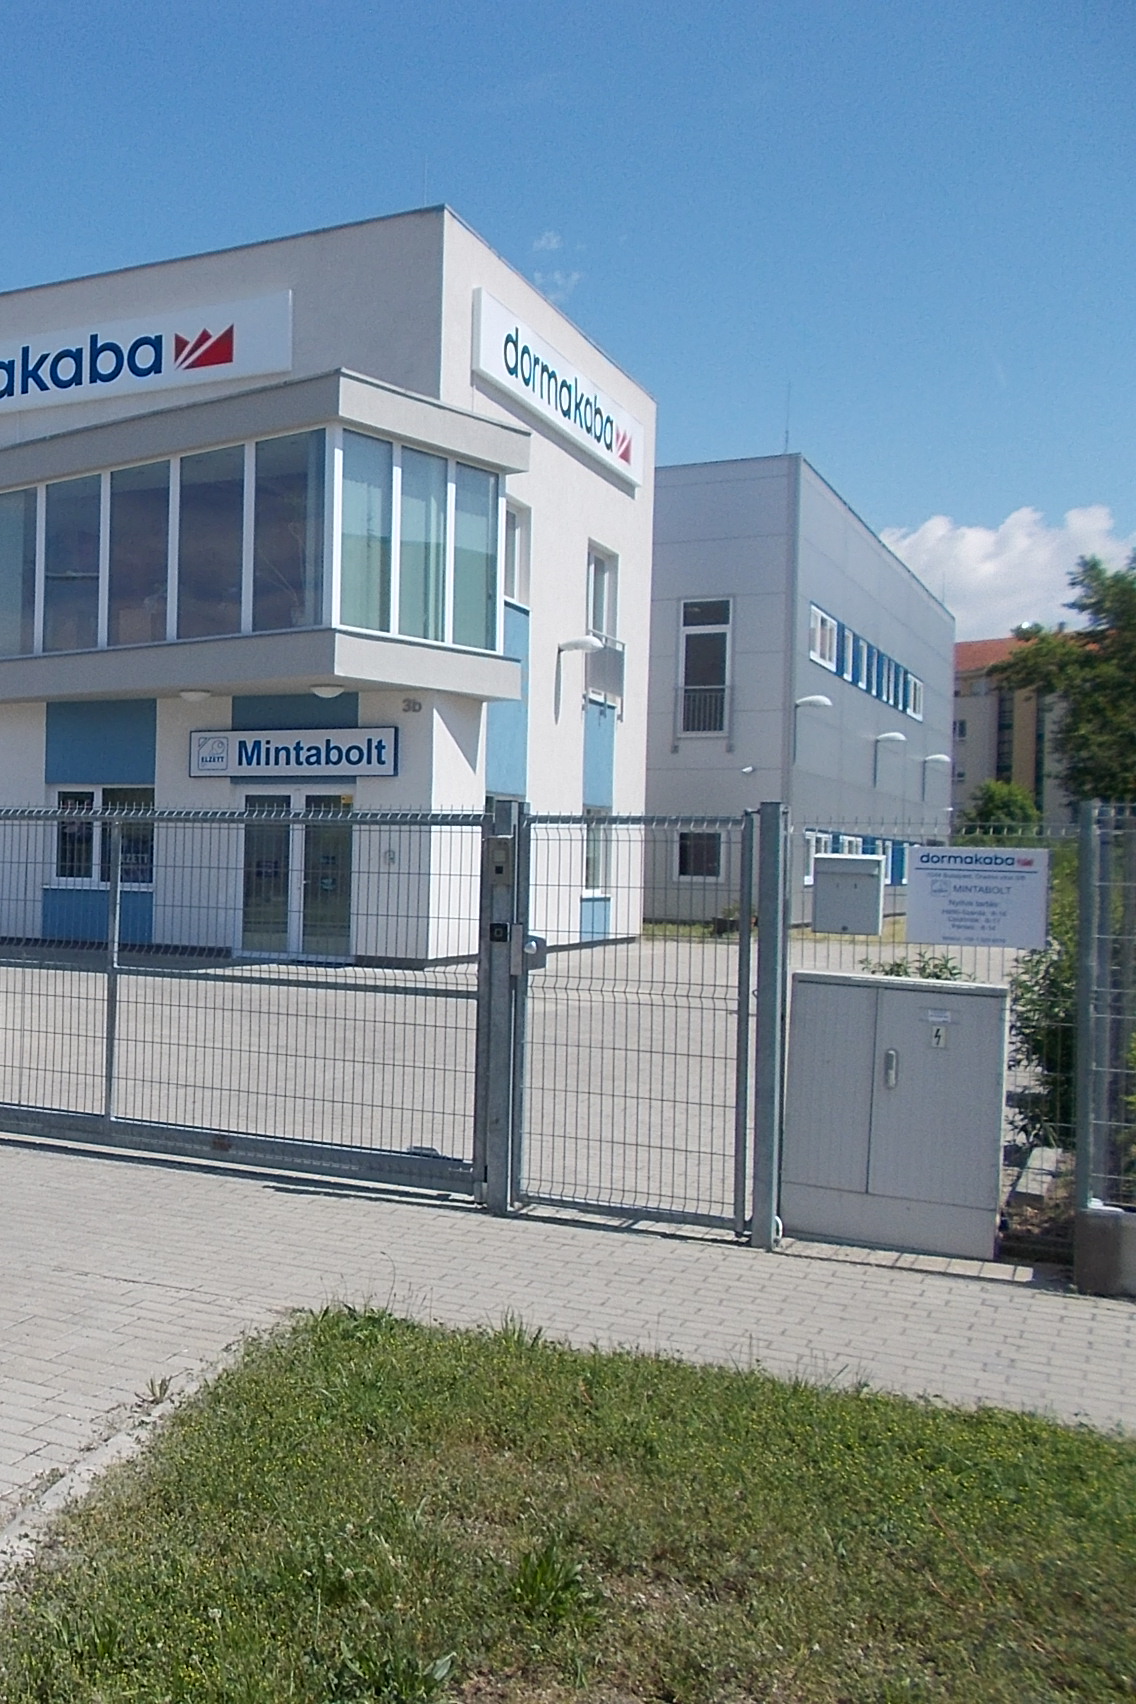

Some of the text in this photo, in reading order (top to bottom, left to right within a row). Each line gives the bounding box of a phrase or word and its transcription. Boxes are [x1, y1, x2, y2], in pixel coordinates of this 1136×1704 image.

[503, 326, 615, 453] dormakaba
[402, 698, 422, 713] 3b
[201, 755, 225, 763] ELZETT
[237, 738, 386, 767] Mintabolt
[920, 852, 1015, 866] dormakaba
[952, 884, 1012, 895] MINTABOLT
